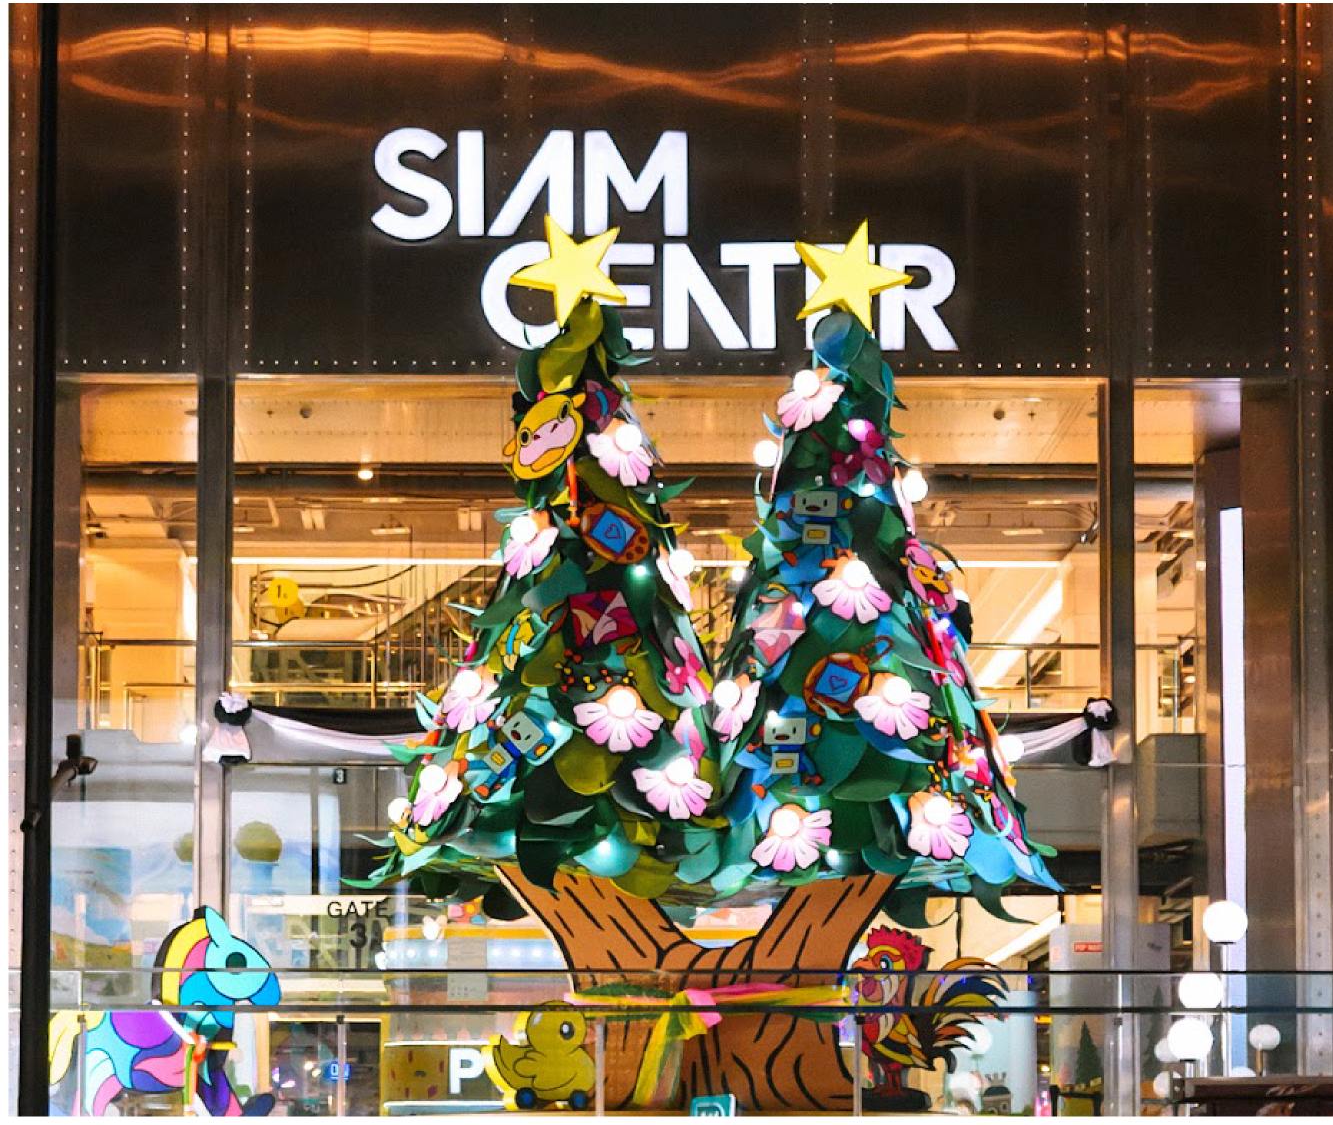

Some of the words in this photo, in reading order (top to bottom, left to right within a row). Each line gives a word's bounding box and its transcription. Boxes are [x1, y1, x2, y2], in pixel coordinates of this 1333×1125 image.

[371, 126, 688, 240] SIAM
[480, 240, 959, 351] CENTR
[327, 901, 389, 919] GATE
[350, 923, 367, 949] 3
